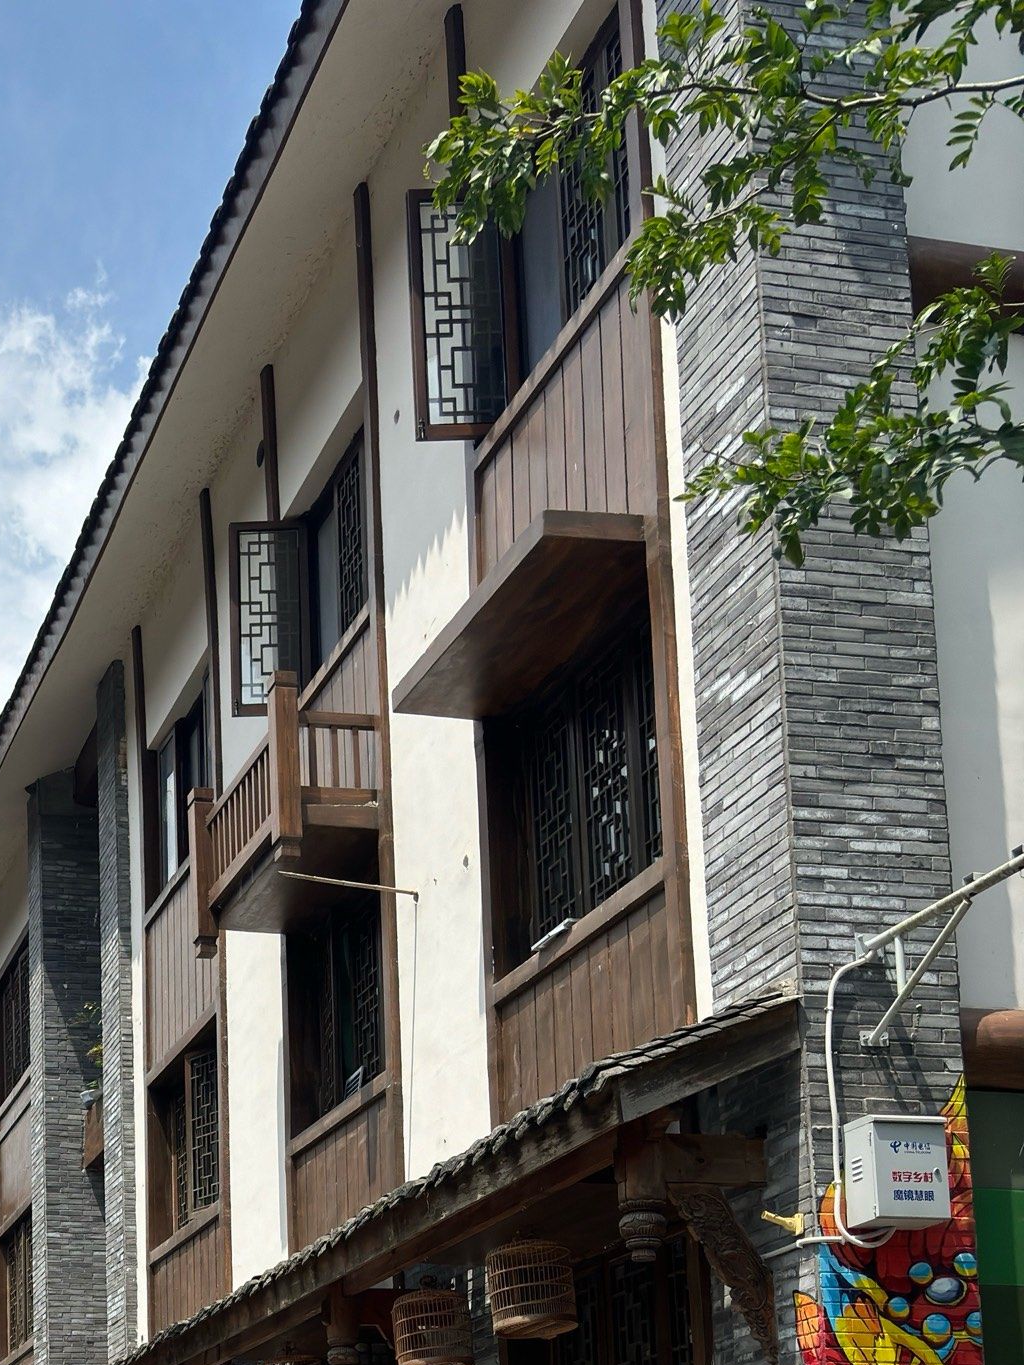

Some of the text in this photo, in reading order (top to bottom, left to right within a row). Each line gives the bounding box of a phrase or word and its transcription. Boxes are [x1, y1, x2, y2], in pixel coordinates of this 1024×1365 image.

[892, 1171, 933, 1183] 数字乡村
[893, 1190, 935, 1201] 魔镜慧眼
